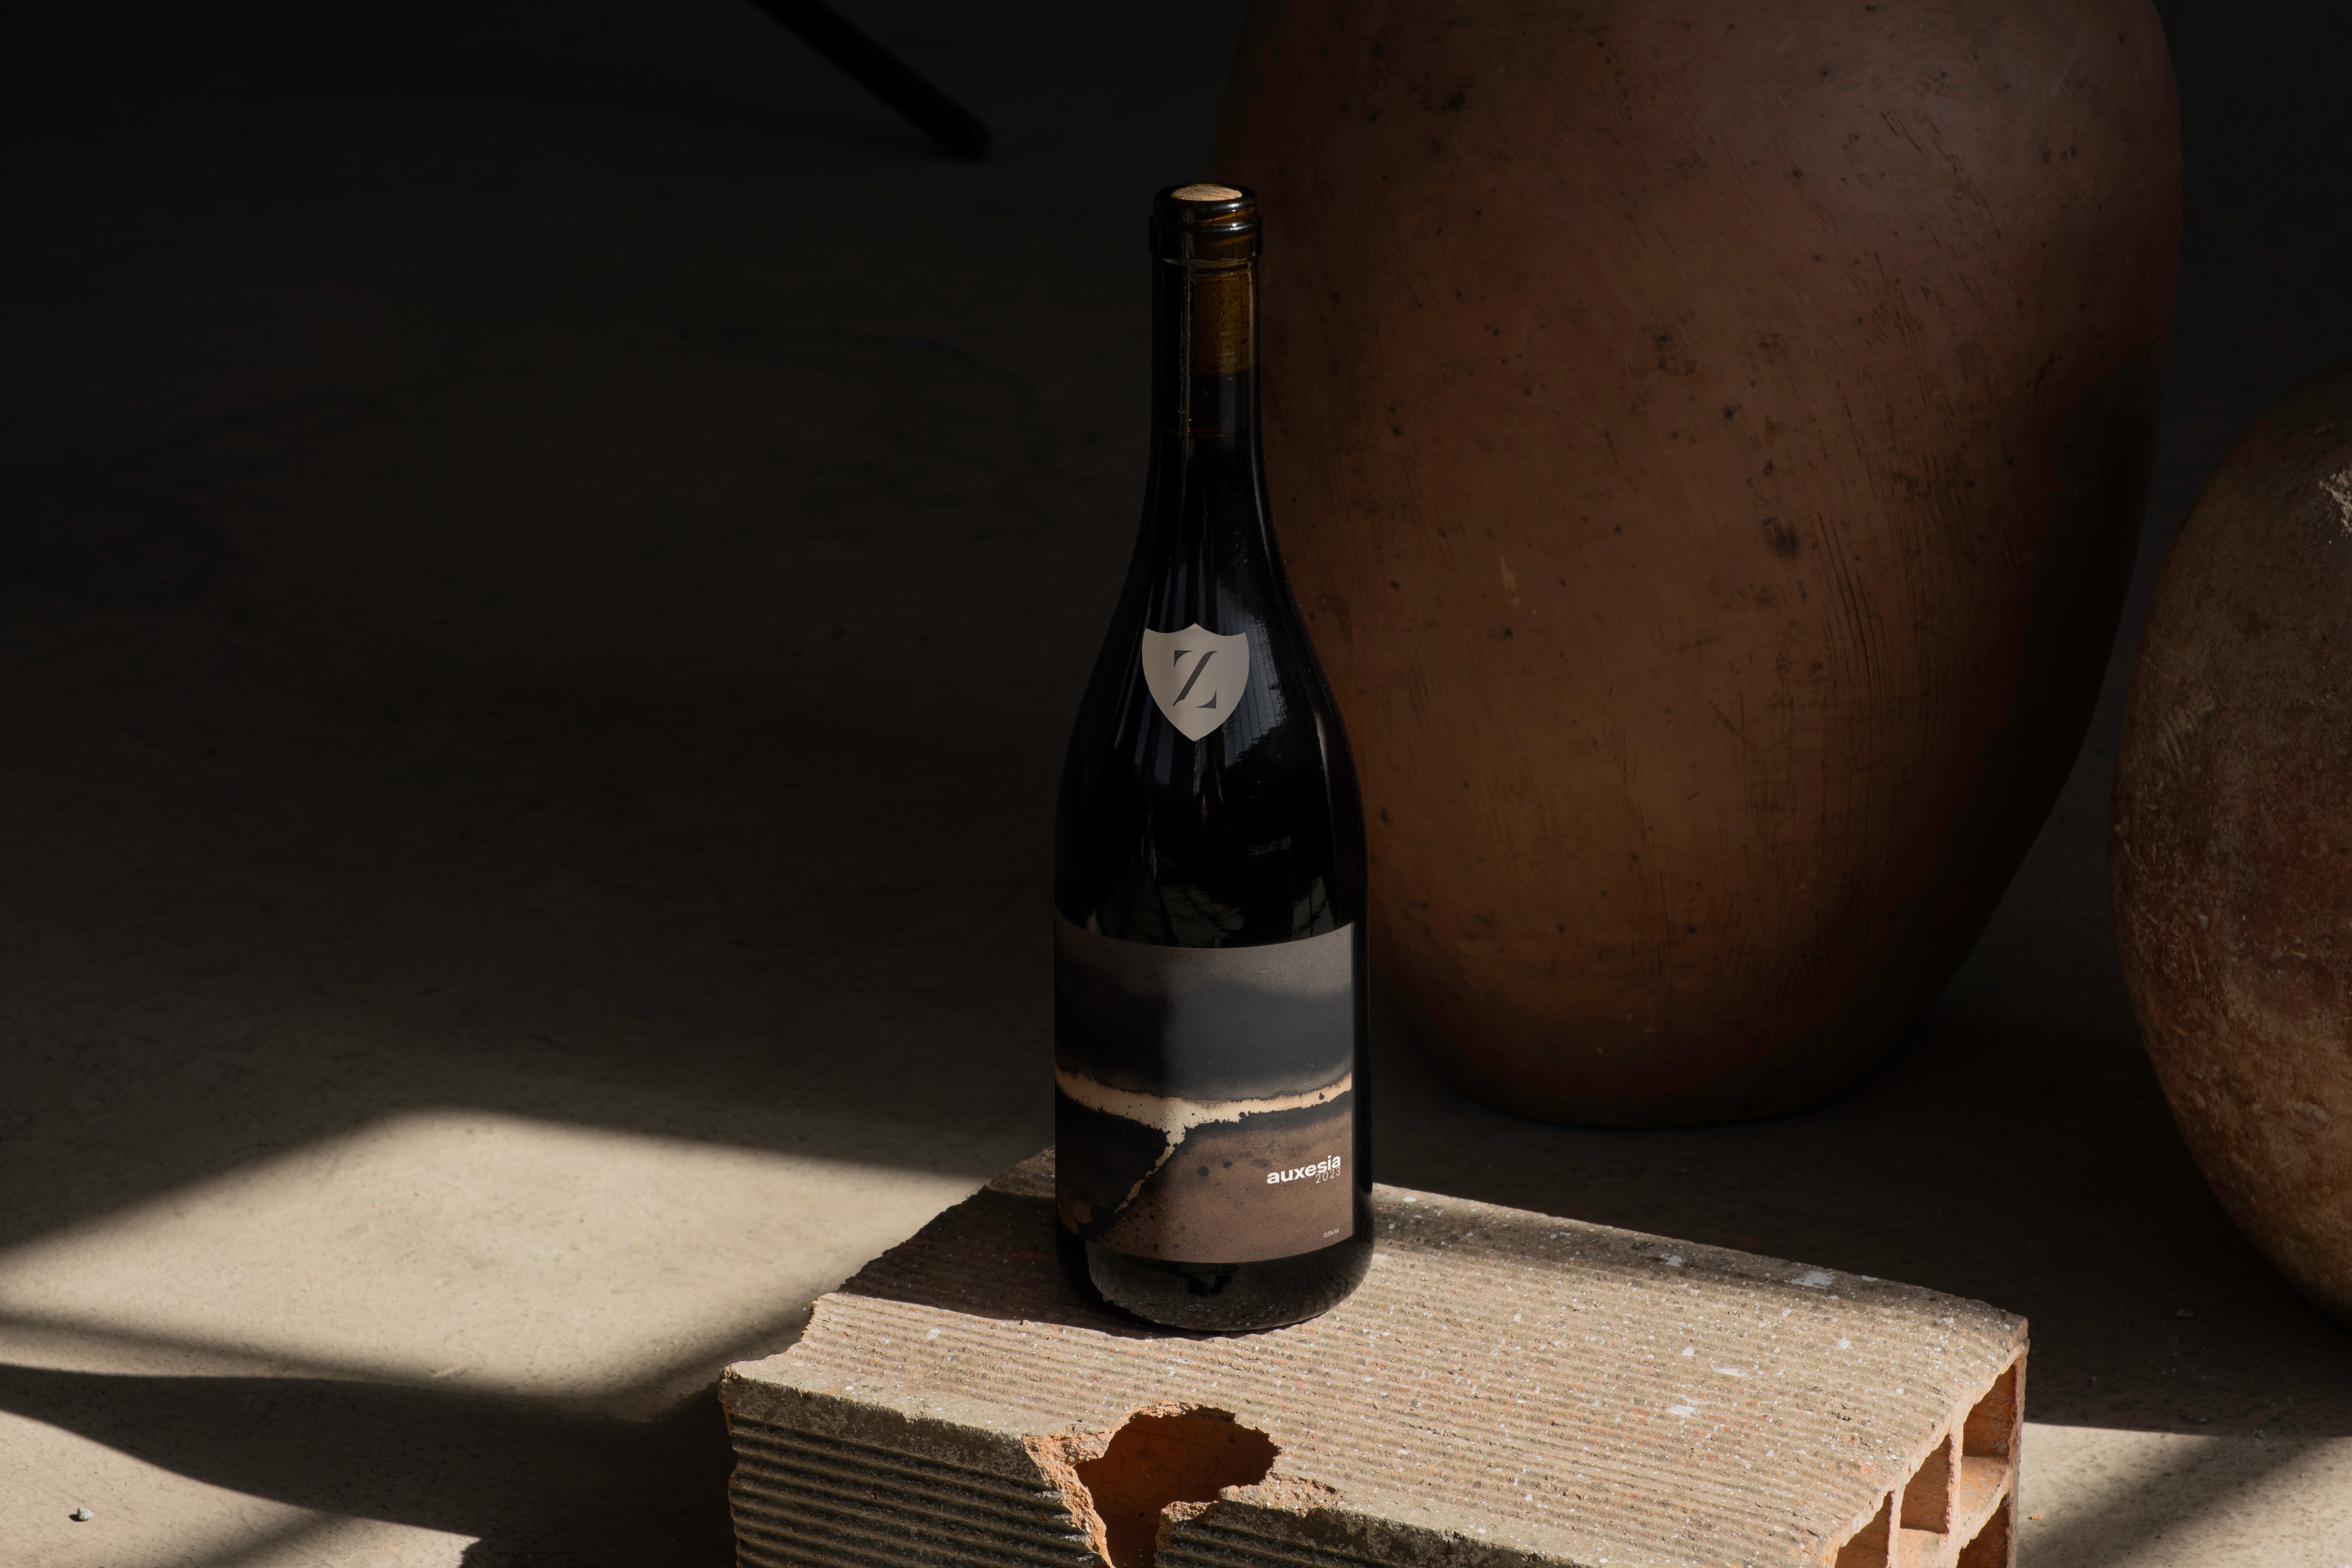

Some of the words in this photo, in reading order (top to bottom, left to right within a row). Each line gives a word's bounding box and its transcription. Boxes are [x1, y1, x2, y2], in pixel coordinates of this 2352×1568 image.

[1173, 650, 1217, 709] Z
[1267, 1155, 1341, 1184] auxesia
[1315, 1167, 1341, 1184] 2023
